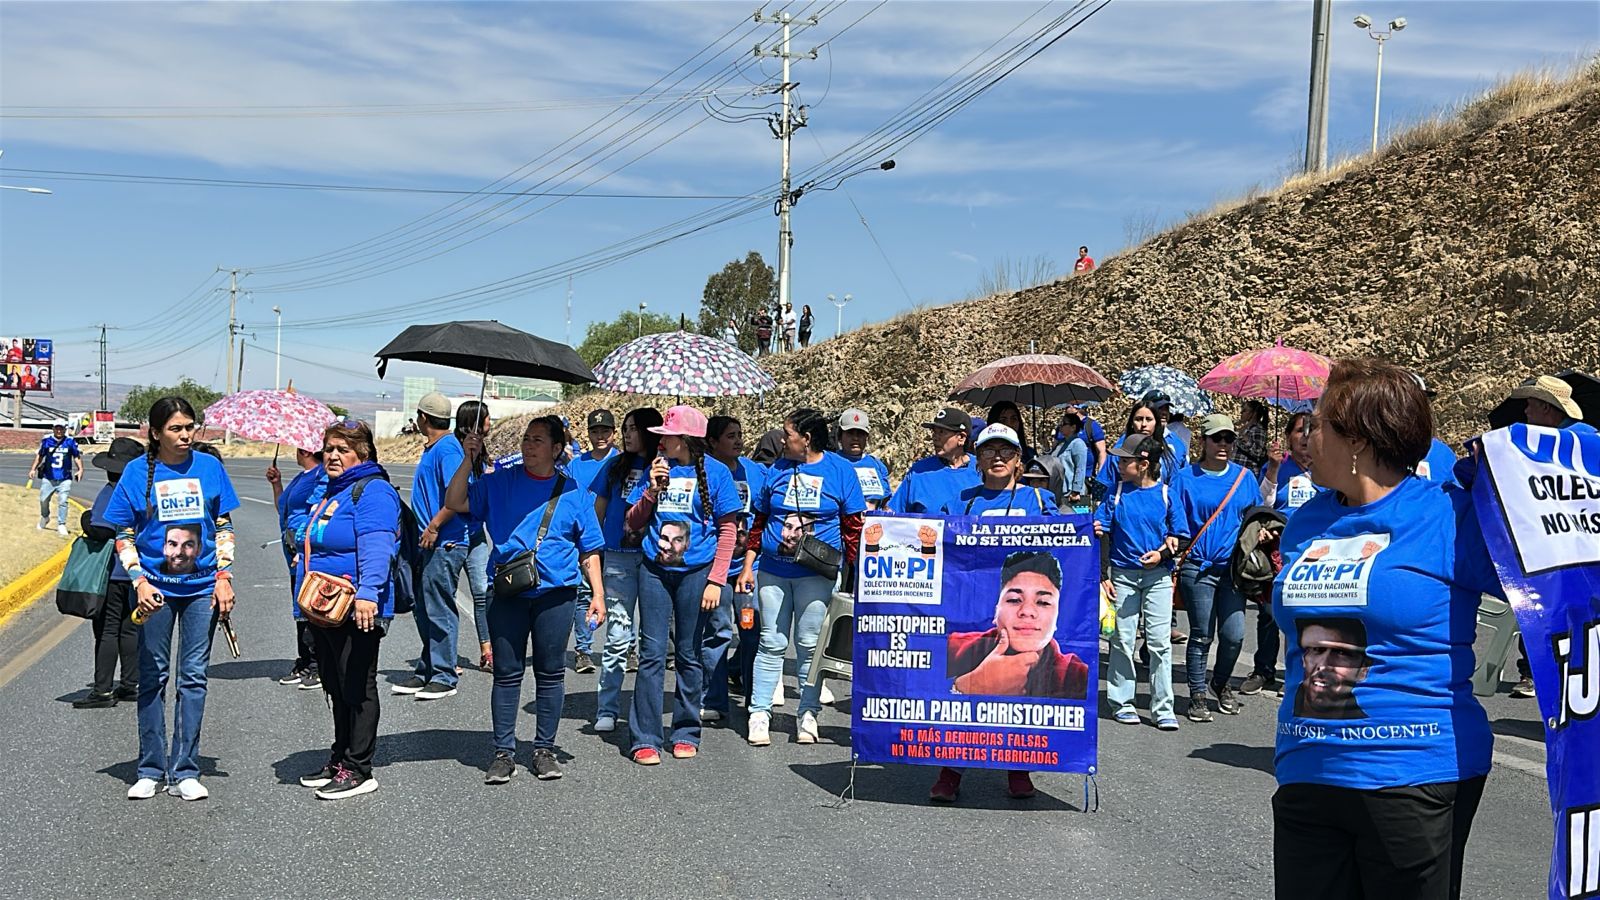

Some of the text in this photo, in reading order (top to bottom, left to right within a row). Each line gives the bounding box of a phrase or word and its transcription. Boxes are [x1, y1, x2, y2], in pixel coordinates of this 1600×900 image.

[51, 452, 63, 469] 3
[161, 497, 178, 509] CN
[185, 496, 200, 508] PI
[678, 492, 690, 503] PI
[1291, 490, 1304, 498] CN
[972, 523, 1076, 535] LA INOCENCIA
[1541, 512, 1571, 535] NO
[955, 535, 1091, 547] NO SE ENCARCELA
[864, 556, 893, 578] CN
[894, 561, 906, 569] NO
[907, 557, 935, 580] PI
[1292, 564, 1326, 582] CN
[1334, 562, 1365, 581] PI
[864, 580, 933, 589] COLECTIVO NACIONAL
[1288, 582, 1358, 591] COLECTIVO NACIONAL
[857, 615, 945, 634] ¡CHRISTOPHER
[890, 633, 907, 650] ES
[867, 649, 931, 669] INOCENTE!
[1557, 623, 1600, 725] ¡J
[862, 697, 1085, 728] JUSTICIA PARA CHRISTOPHER
[901, 727, 1048, 748] NO MÁS DENUNCIAS FALSAS
[1293, 724, 1327, 739] JOSE
[1341, 722, 1441, 740] INOCENTE
[891, 743, 1059, 765] NO MÁS CARPETAS FABRICADAS
